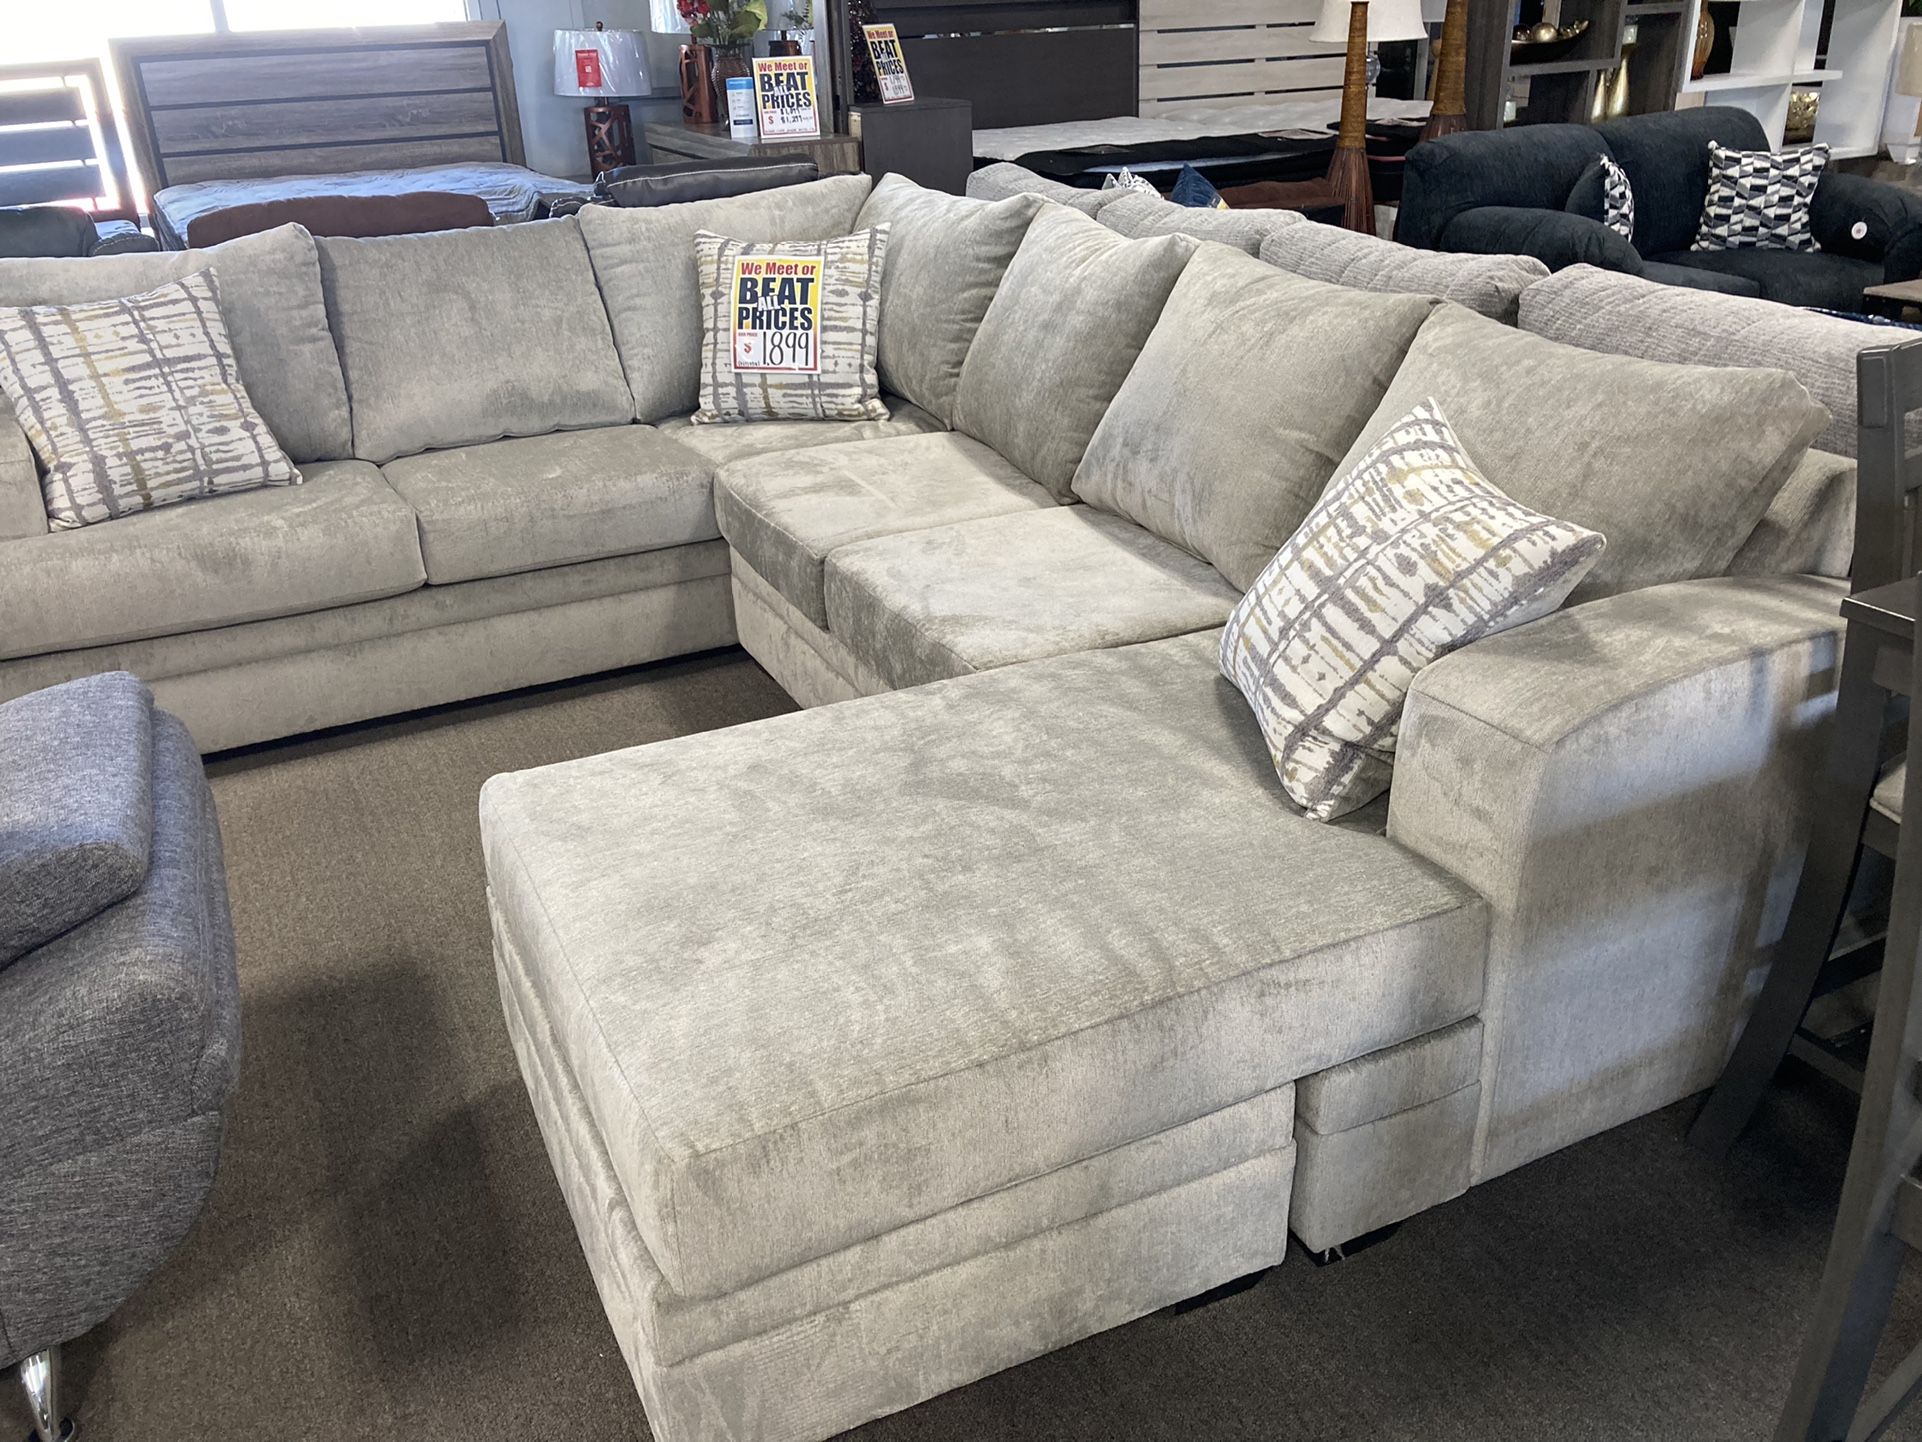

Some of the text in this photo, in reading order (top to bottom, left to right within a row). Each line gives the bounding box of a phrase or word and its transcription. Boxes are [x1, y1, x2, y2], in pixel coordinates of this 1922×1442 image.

[870, 40, 898, 59] BEAT
[758, 62, 808, 72] We Meet or
[876, 59, 904, 76] PRICES
[759, 72, 808, 92] BEAT
[761, 92, 812, 109] PRICES
[741, 262, 816, 275] We Meet or
[738, 277, 815, 305] BEAT
[757, 295, 781, 311] ALL
[737, 307, 813, 331] PRICES
